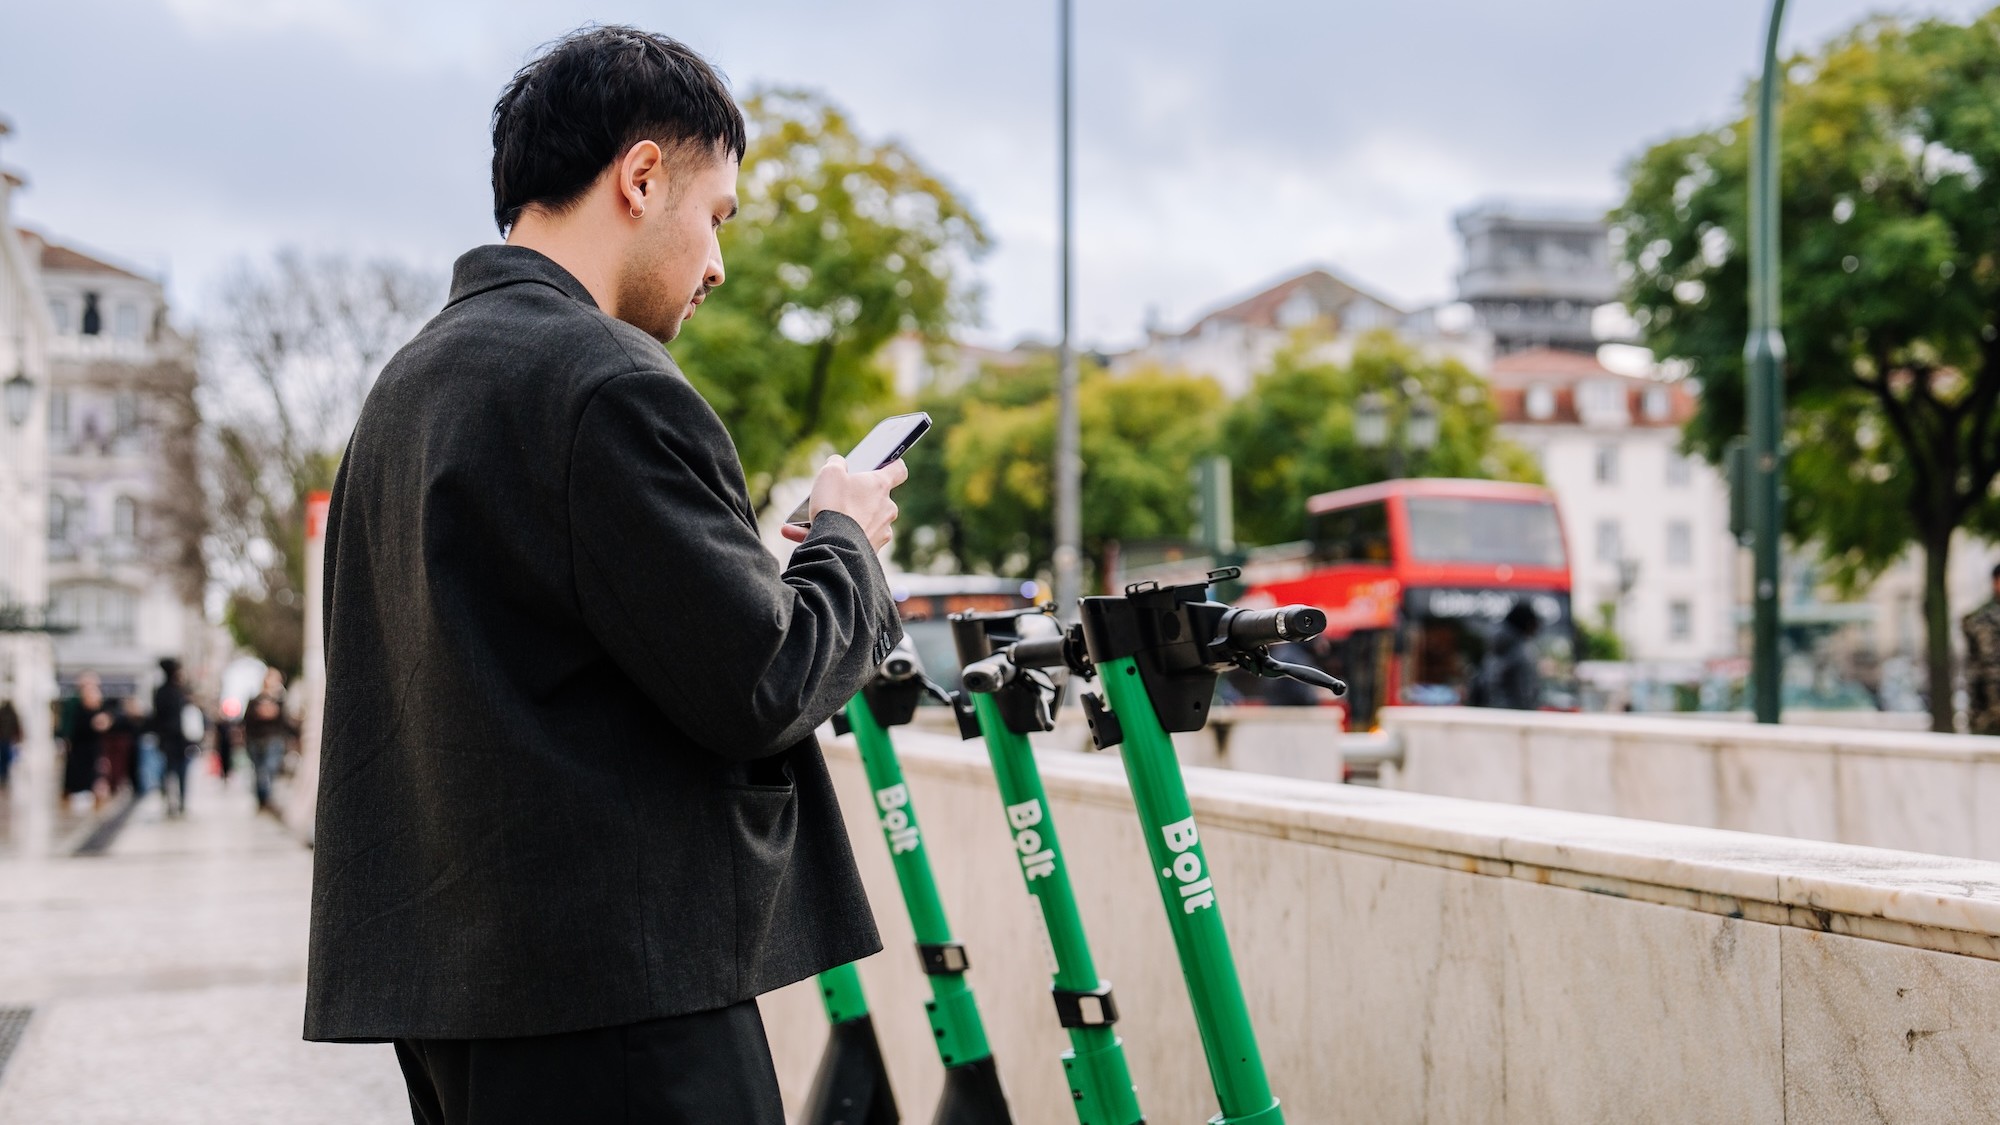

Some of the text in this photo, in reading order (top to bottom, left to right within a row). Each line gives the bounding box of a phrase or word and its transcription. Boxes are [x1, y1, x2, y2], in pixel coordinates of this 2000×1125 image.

[876, 784, 919, 854] Bolt
[1007, 799, 1056, 880] Bolt
[1162, 816, 1214, 914] Bolt
